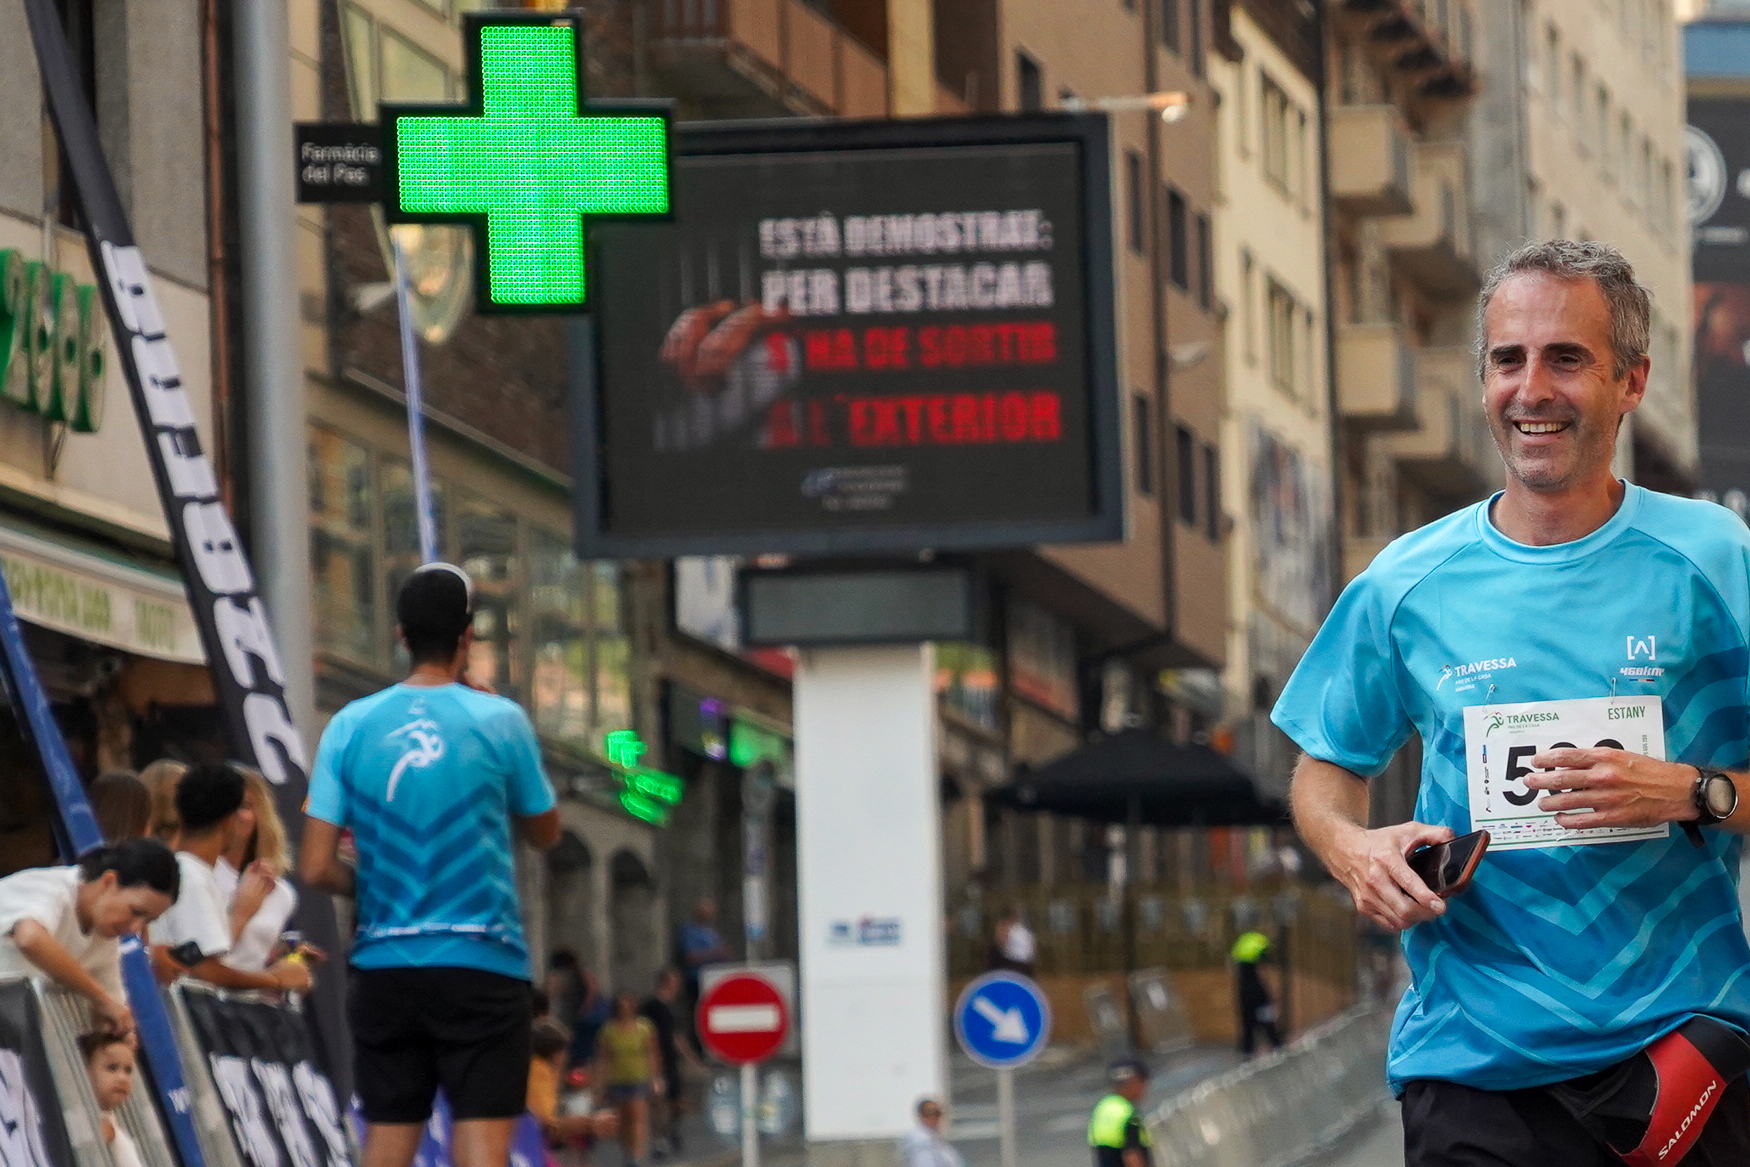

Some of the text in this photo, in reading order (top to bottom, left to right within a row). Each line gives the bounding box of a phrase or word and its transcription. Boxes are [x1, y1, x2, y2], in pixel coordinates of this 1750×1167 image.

[760, 260, 1055, 317] PER DESTACAR
[1454, 657, 1517, 677] TRAVESSA
[1507, 712, 1560, 724] TRAVESSA
[1607, 706, 1646, 720] ESTANY
[1658, 1080, 1717, 1160] SALOMON
